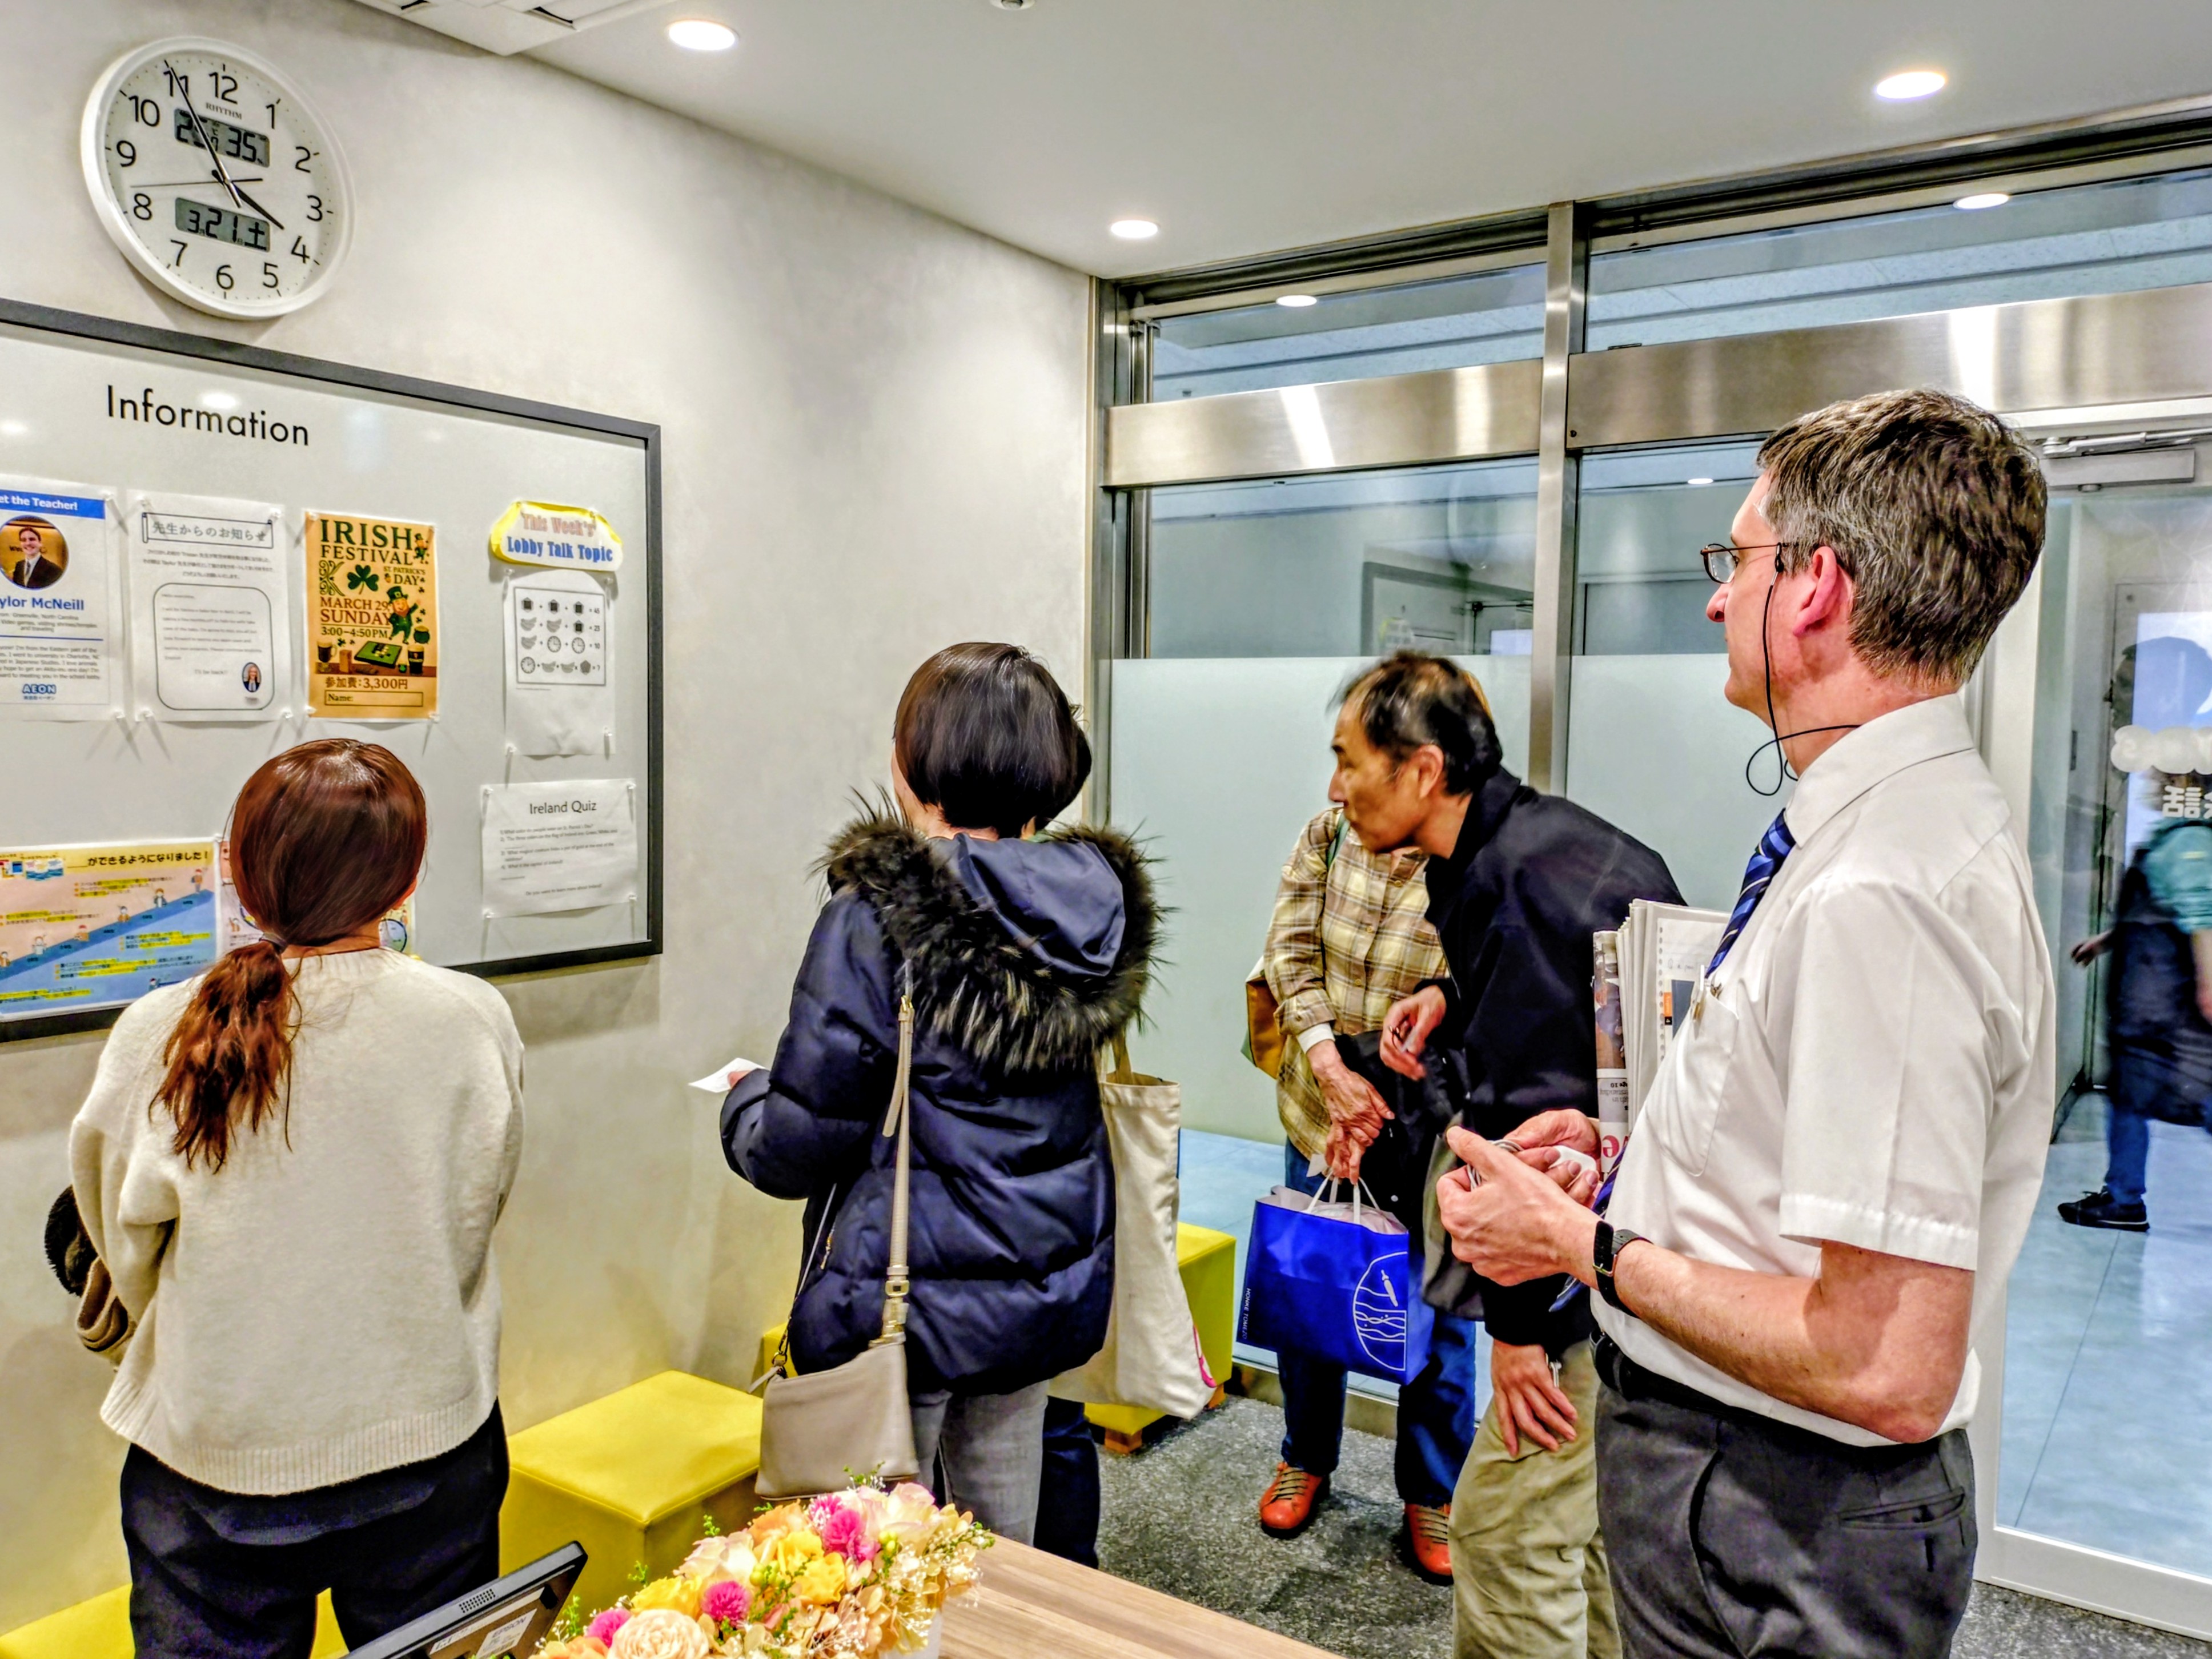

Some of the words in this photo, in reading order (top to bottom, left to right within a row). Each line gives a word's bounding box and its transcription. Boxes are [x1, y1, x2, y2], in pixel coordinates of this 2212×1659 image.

[163, 69, 190, 97] 11
[209, 71, 238, 104] 12
[129, 95, 160, 127] 10
[206, 102, 242, 119] RHYTHM
[266, 103, 275, 129] 1
[116, 140, 137, 167] 9
[295, 146, 311, 173] 2
[133, 193, 152, 220] 8
[307, 195, 323, 222] 3
[170, 239, 188, 267] 7
[290, 235, 311, 264] 4
[216, 264, 234, 290] 6
[262, 262, 279, 289] 5
[107, 384, 309, 446] Information
[11, 495, 30, 506] the
[32, 497, 79, 511] Teacher!
[152, 521, 267, 542] 先生からのお知らせ
[320, 519, 412, 551] IRISH
[522, 513, 548, 532] This
[551, 516, 595, 537] Week's
[321, 544, 413, 566] FESTIVAL
[507, 536, 543, 557] Lobby
[547, 540, 574, 559] Talk
[577, 544, 614, 563] Topic
[393, 567, 426, 576] PATRICK'S
[394, 574, 420, 586] DAY
[32, 597, 85, 611] McNeill
[320, 597, 372, 610] MARCH
[320, 608, 392, 626] SUNDAY
[22, 683, 57, 694] AEON
[327, 693, 354, 702] Name:
[529, 801, 568, 814] Ireland
[571, 800, 597, 813] Quiz
[87, 850, 209, 867] ができるようになりました！
